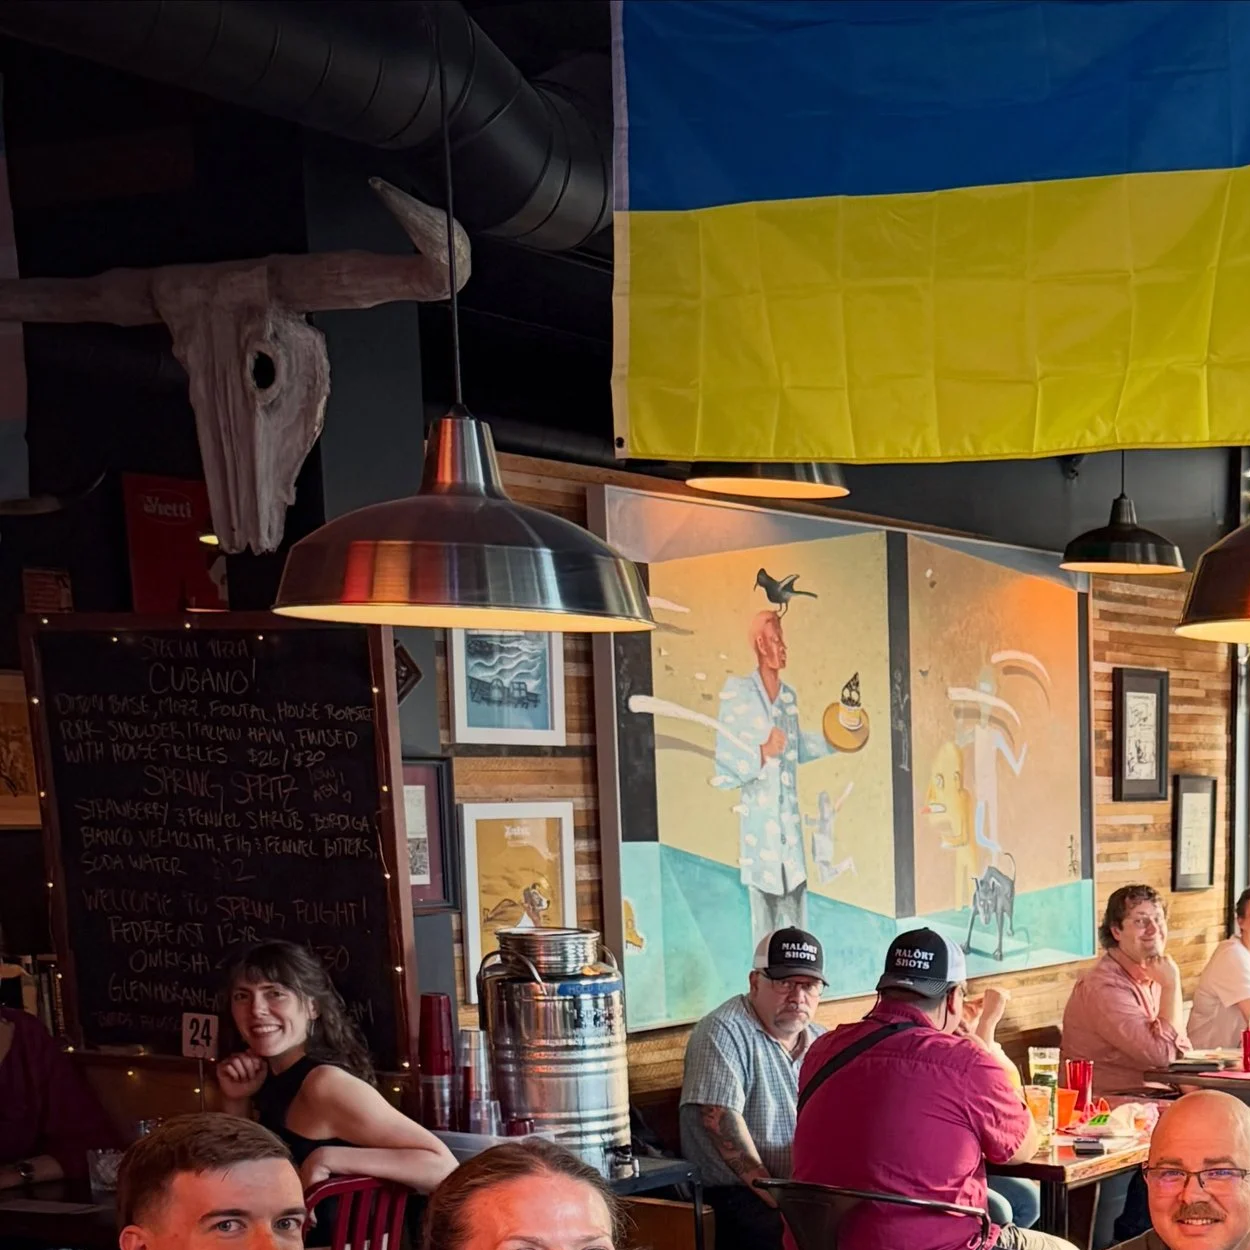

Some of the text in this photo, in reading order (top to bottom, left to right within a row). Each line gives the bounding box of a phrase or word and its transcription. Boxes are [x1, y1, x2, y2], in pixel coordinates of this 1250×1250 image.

[150, 656, 261, 694] CUBANO!
[277, 700, 321, 722] HOUSE
[63, 741, 104, 763] WITH
[112, 742, 157, 763] HOUSE
[143, 764, 224, 815] SPRING
[80, 850, 124, 875] SODA
[129, 853, 188, 876] WATER
[82, 888, 172, 917] WELCOME
[785, 952, 817, 963] SHOTS
[895, 957, 930, 970] SHOTS
[188, 1018, 212, 1048] 24
